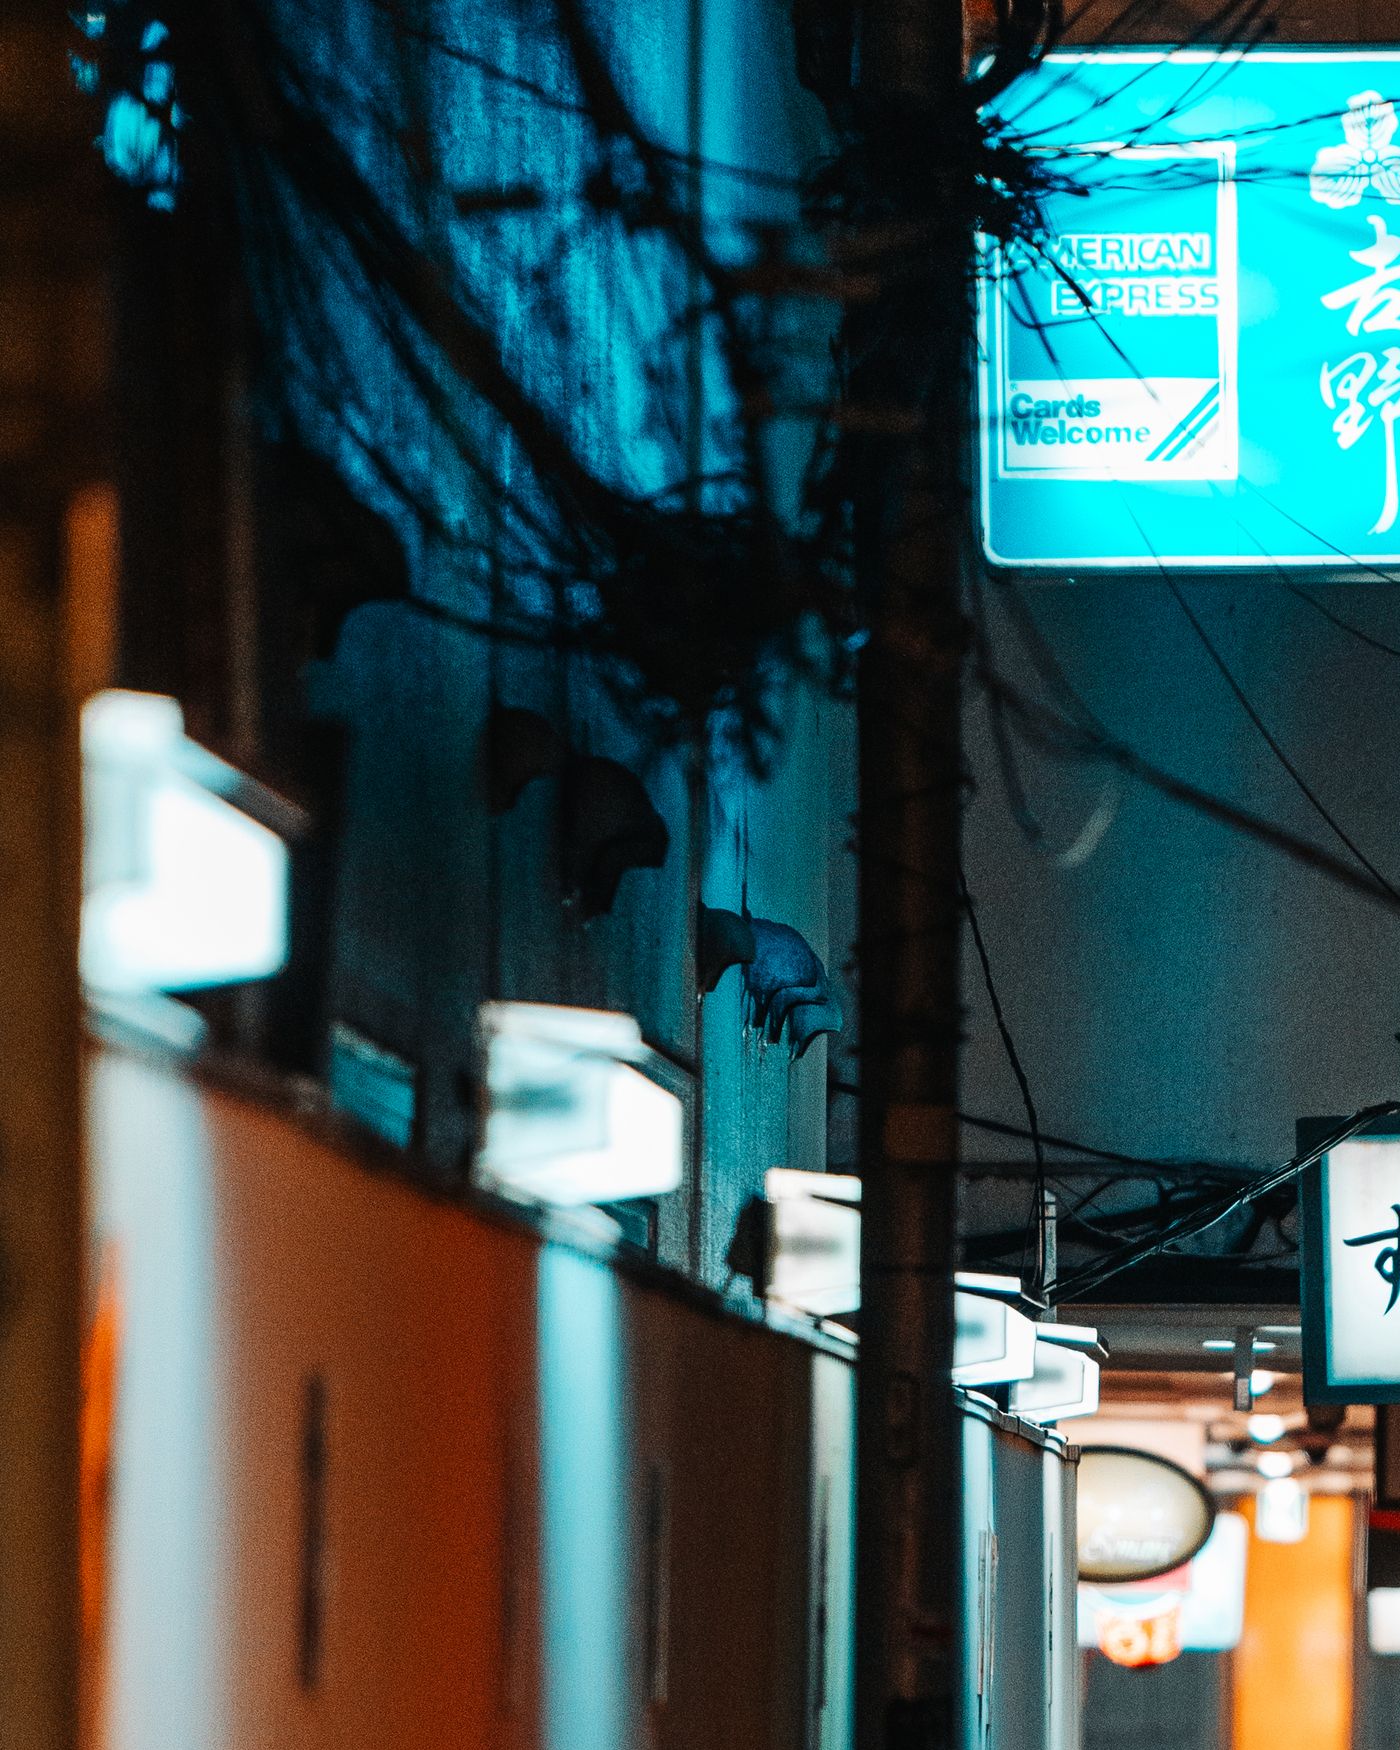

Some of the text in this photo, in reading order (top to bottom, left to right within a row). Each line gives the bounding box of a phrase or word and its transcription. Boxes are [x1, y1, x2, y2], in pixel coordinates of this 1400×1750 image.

[1038, 237, 1205, 267] MERICAN
[1055, 282, 1220, 312] EXPRESS
[1009, 392, 1102, 420] Cards
[1010, 419, 1152, 446] Welcome
